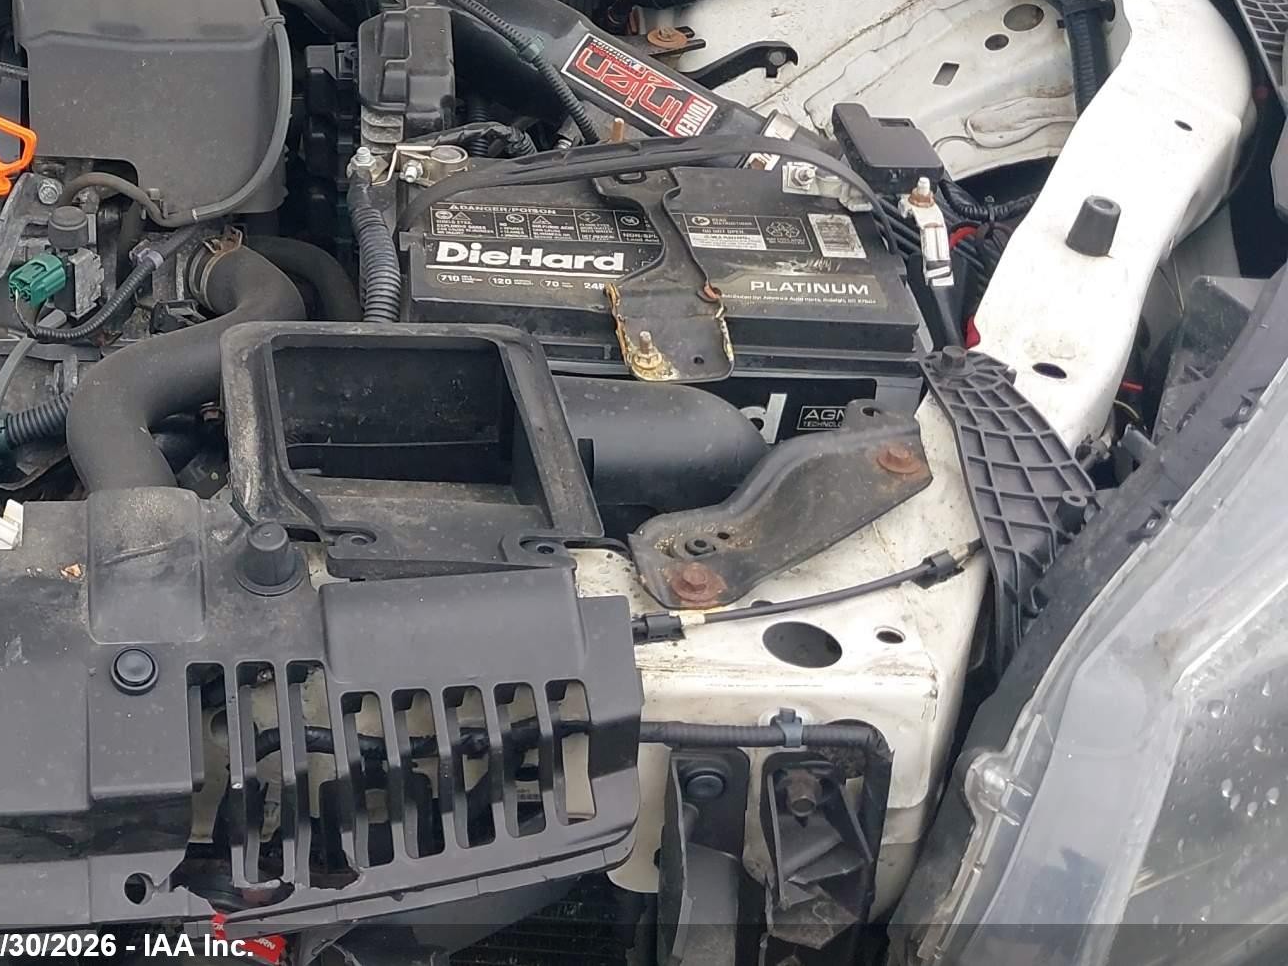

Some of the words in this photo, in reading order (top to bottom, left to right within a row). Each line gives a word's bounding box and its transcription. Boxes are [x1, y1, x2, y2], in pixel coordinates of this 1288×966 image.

[575, 47, 683, 129] injen
[435, 241, 625, 272] DieHard
[440, 274, 460, 282] 710
[492, 277, 512, 285] 120
[750, 281, 869, 296] PLATINUM
